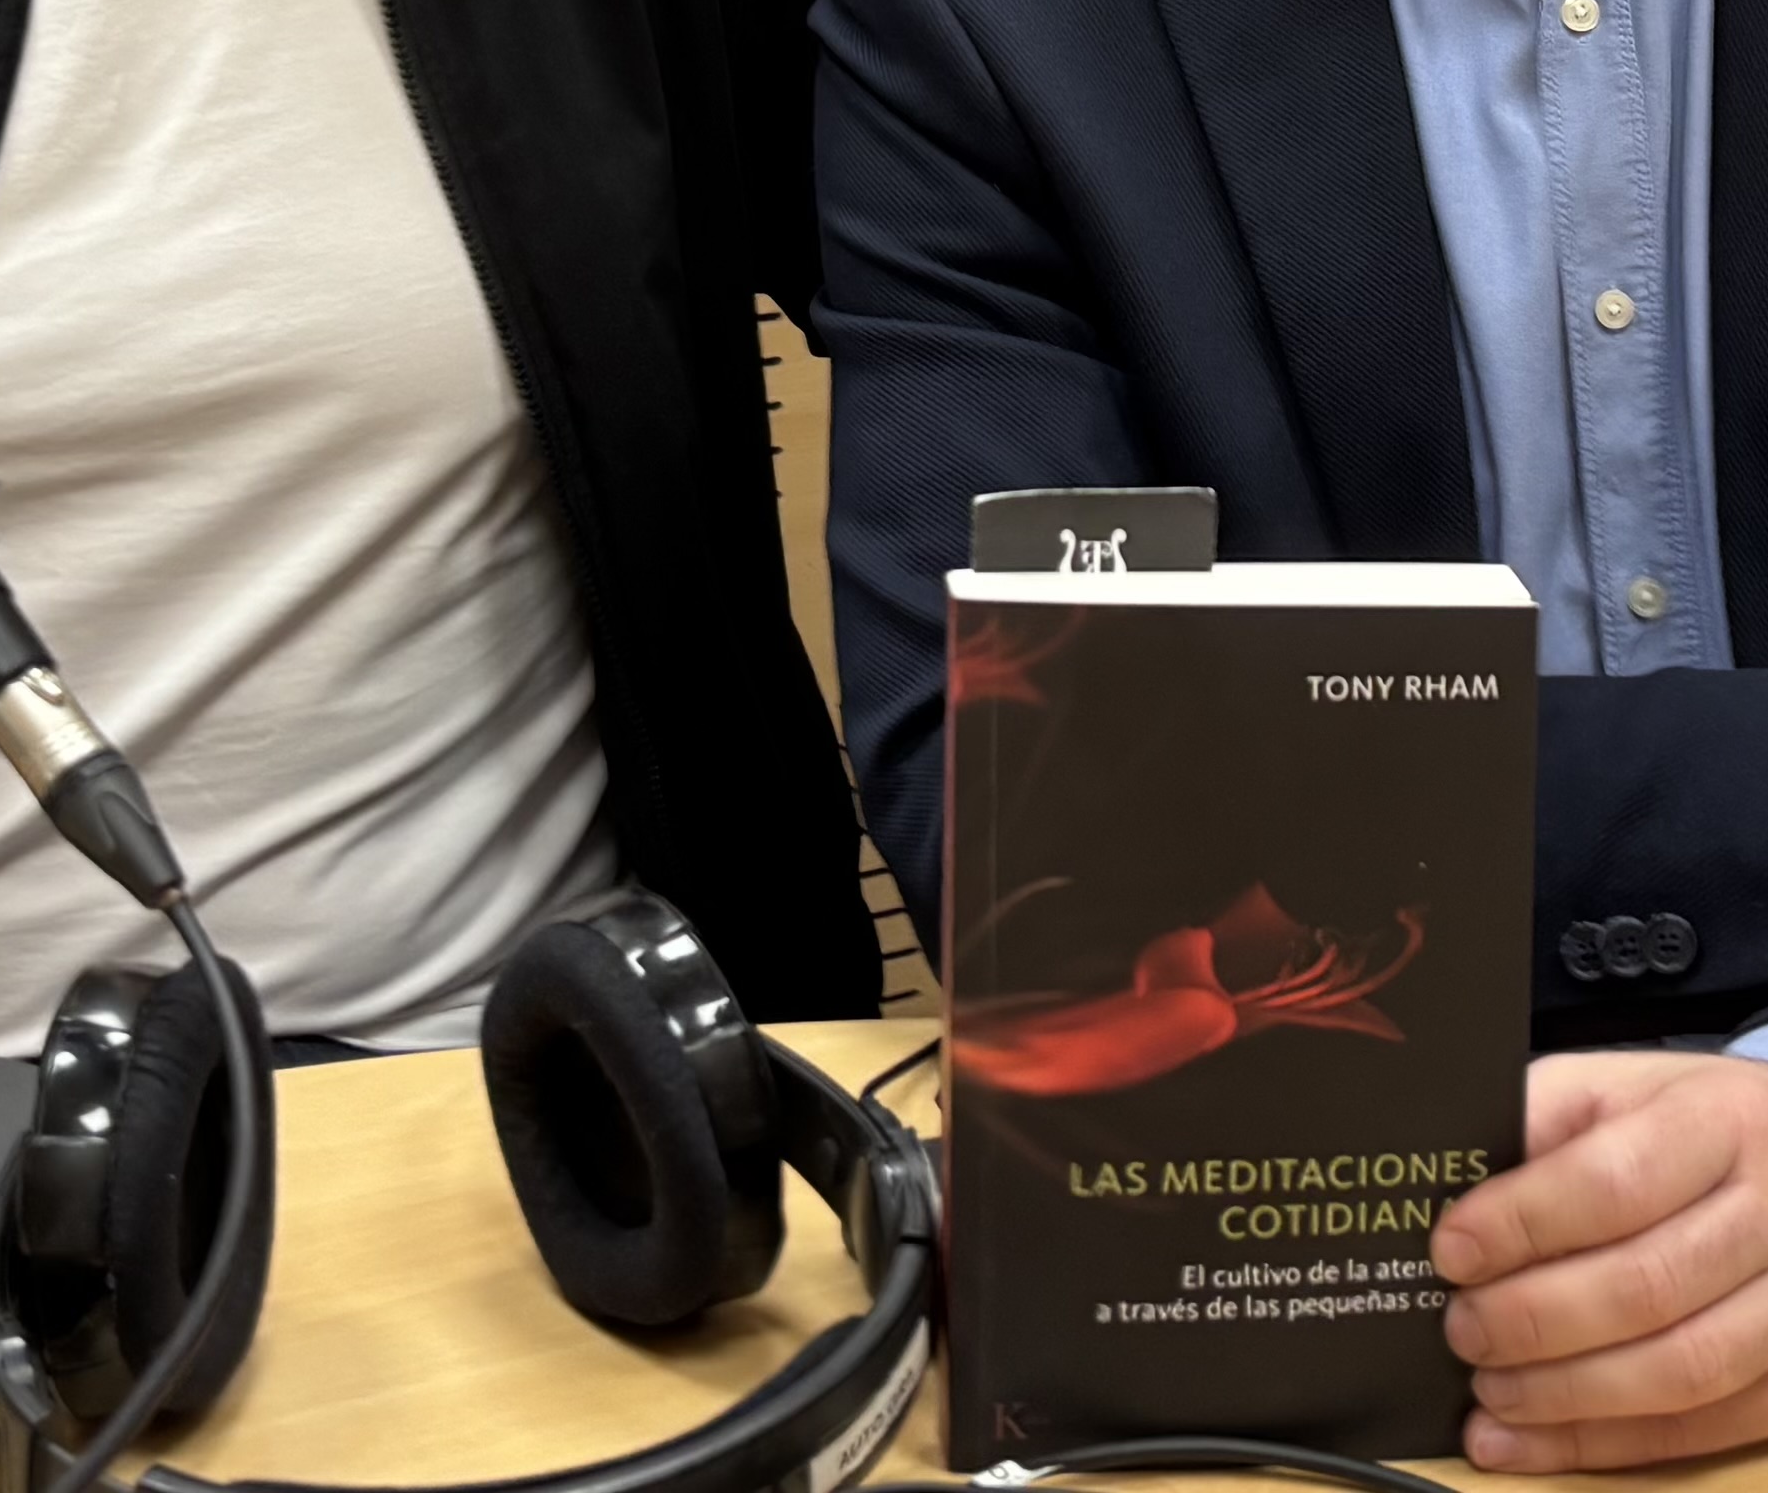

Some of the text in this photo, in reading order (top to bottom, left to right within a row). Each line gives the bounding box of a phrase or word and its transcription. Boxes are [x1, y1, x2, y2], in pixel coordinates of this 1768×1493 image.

[1306, 673, 1500, 702] TONY RHAM
[1069, 1149, 1489, 1198] LAS MEDITACIONES
[1219, 1197, 1453, 1241] COTIDIAN
[1182, 1258, 1433, 1290] El cultivo de la aten
[1095, 1289, 1446, 1323] a través de las pequeñas co
